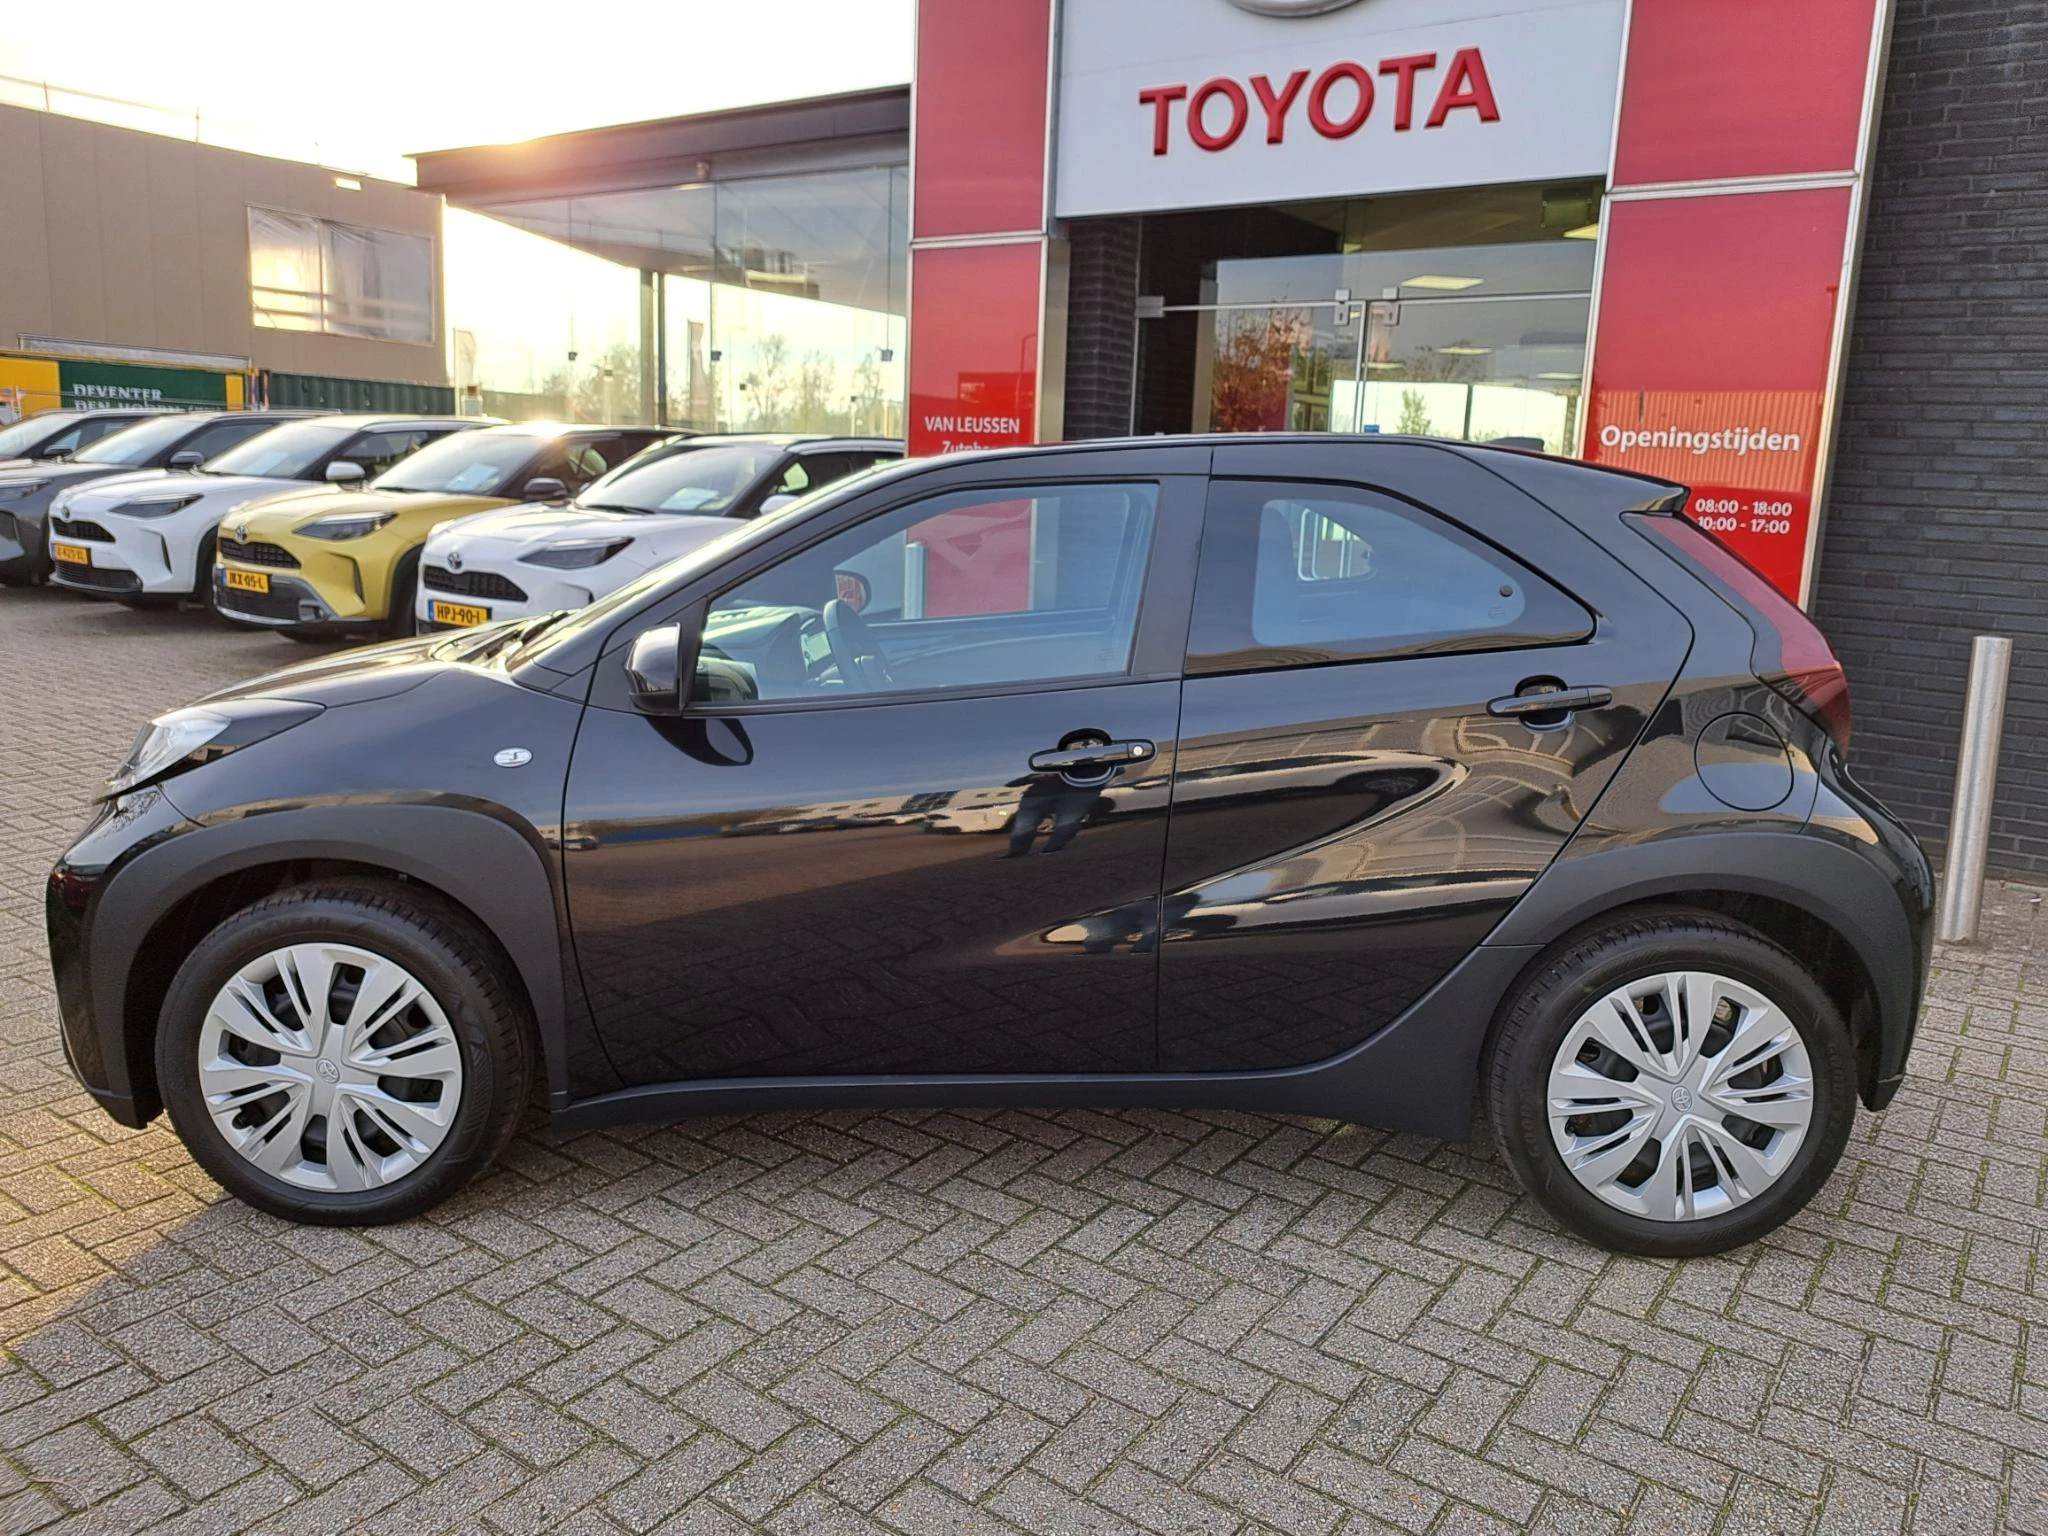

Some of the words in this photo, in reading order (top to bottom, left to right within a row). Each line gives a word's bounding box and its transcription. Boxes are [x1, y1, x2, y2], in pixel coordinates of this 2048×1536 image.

[1139, 46, 1500, 156] TOYOTA
[73, 383, 162, 401] DEVENTER
[924, 416, 954, 432] VAN
[957, 417, 1020, 434] LEUSSEN
[1600, 425, 1801, 456] Openingstijden
[1695, 498, 1739, 514] 08:00
[1752, 501, 1792, 517] 18:00
[1698, 516, 1737, 532] 10:00
[1750, 518, 1790, 535] 17:00
